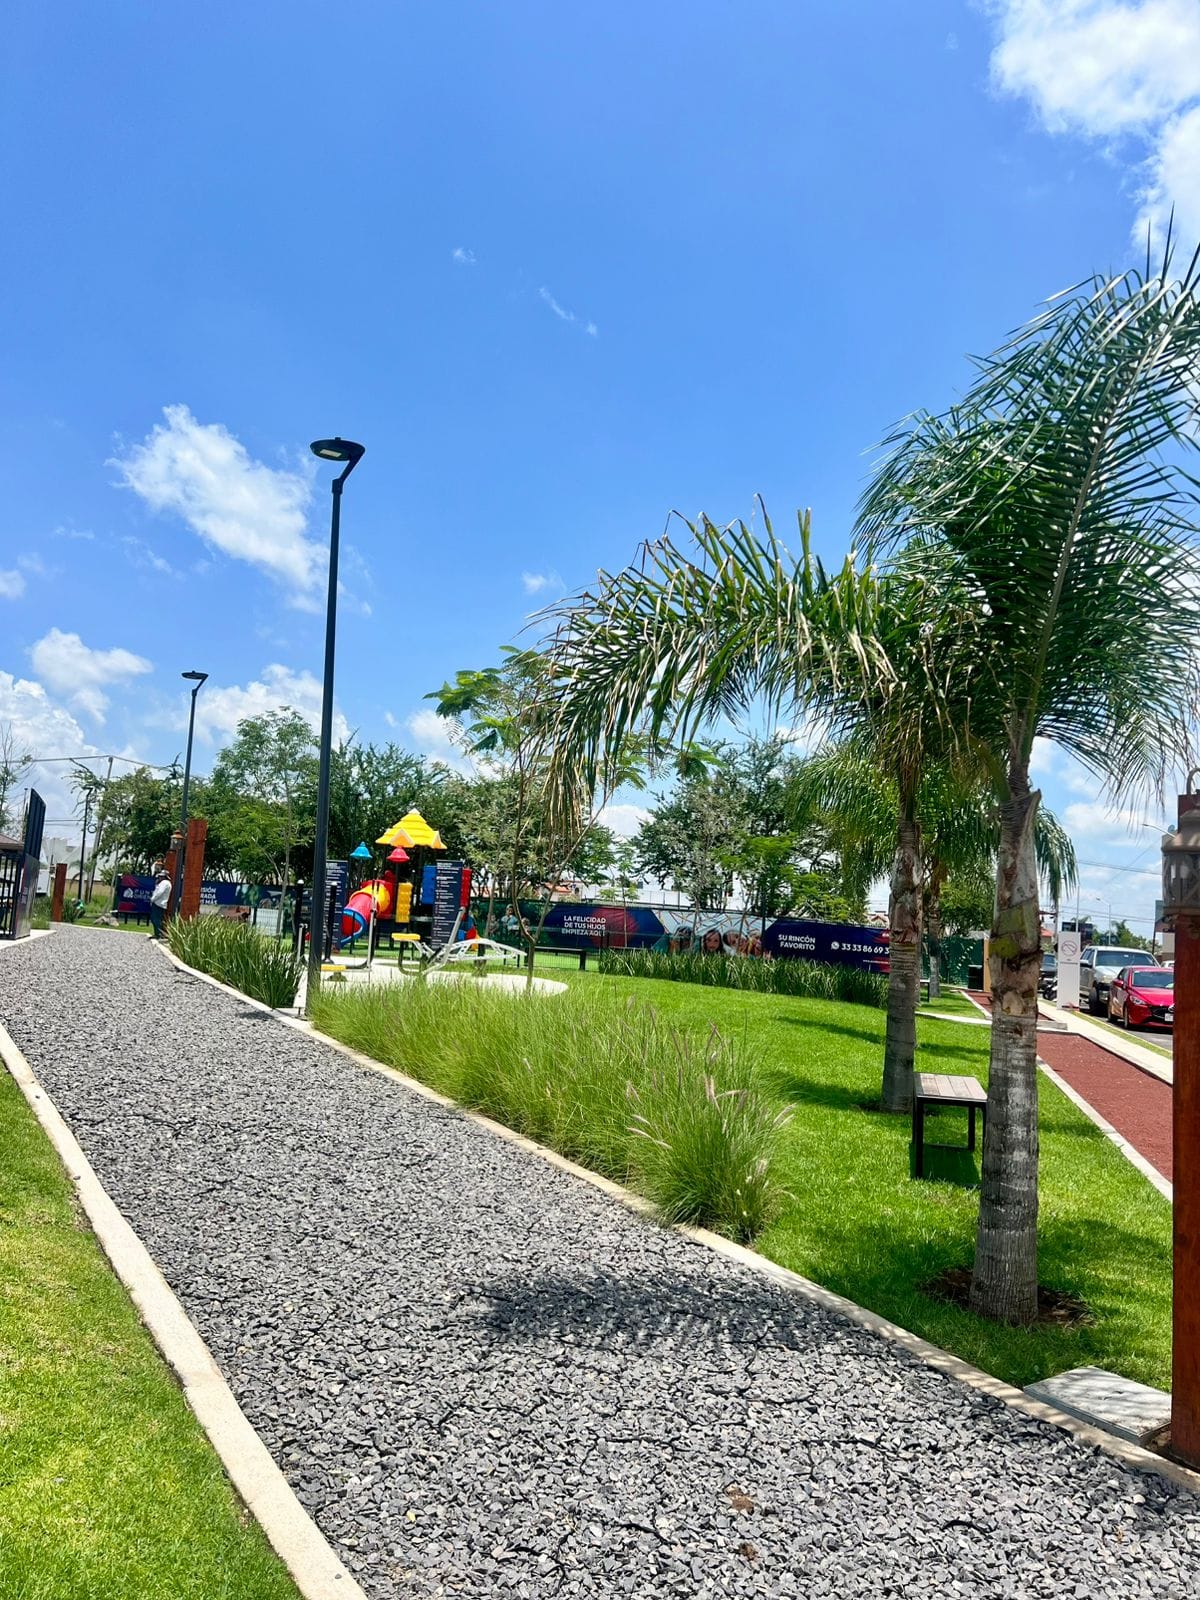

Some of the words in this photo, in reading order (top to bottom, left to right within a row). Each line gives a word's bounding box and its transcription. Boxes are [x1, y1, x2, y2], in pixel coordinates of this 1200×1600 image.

[788, 934, 815, 943] RINCÓN
[780, 942, 815, 950] FAVORITO
[841, 943, 851, 951] 33
[852, 944, 862, 952] 33
[863, 945, 872, 953] 86
[873, 946, 883, 954] 69
